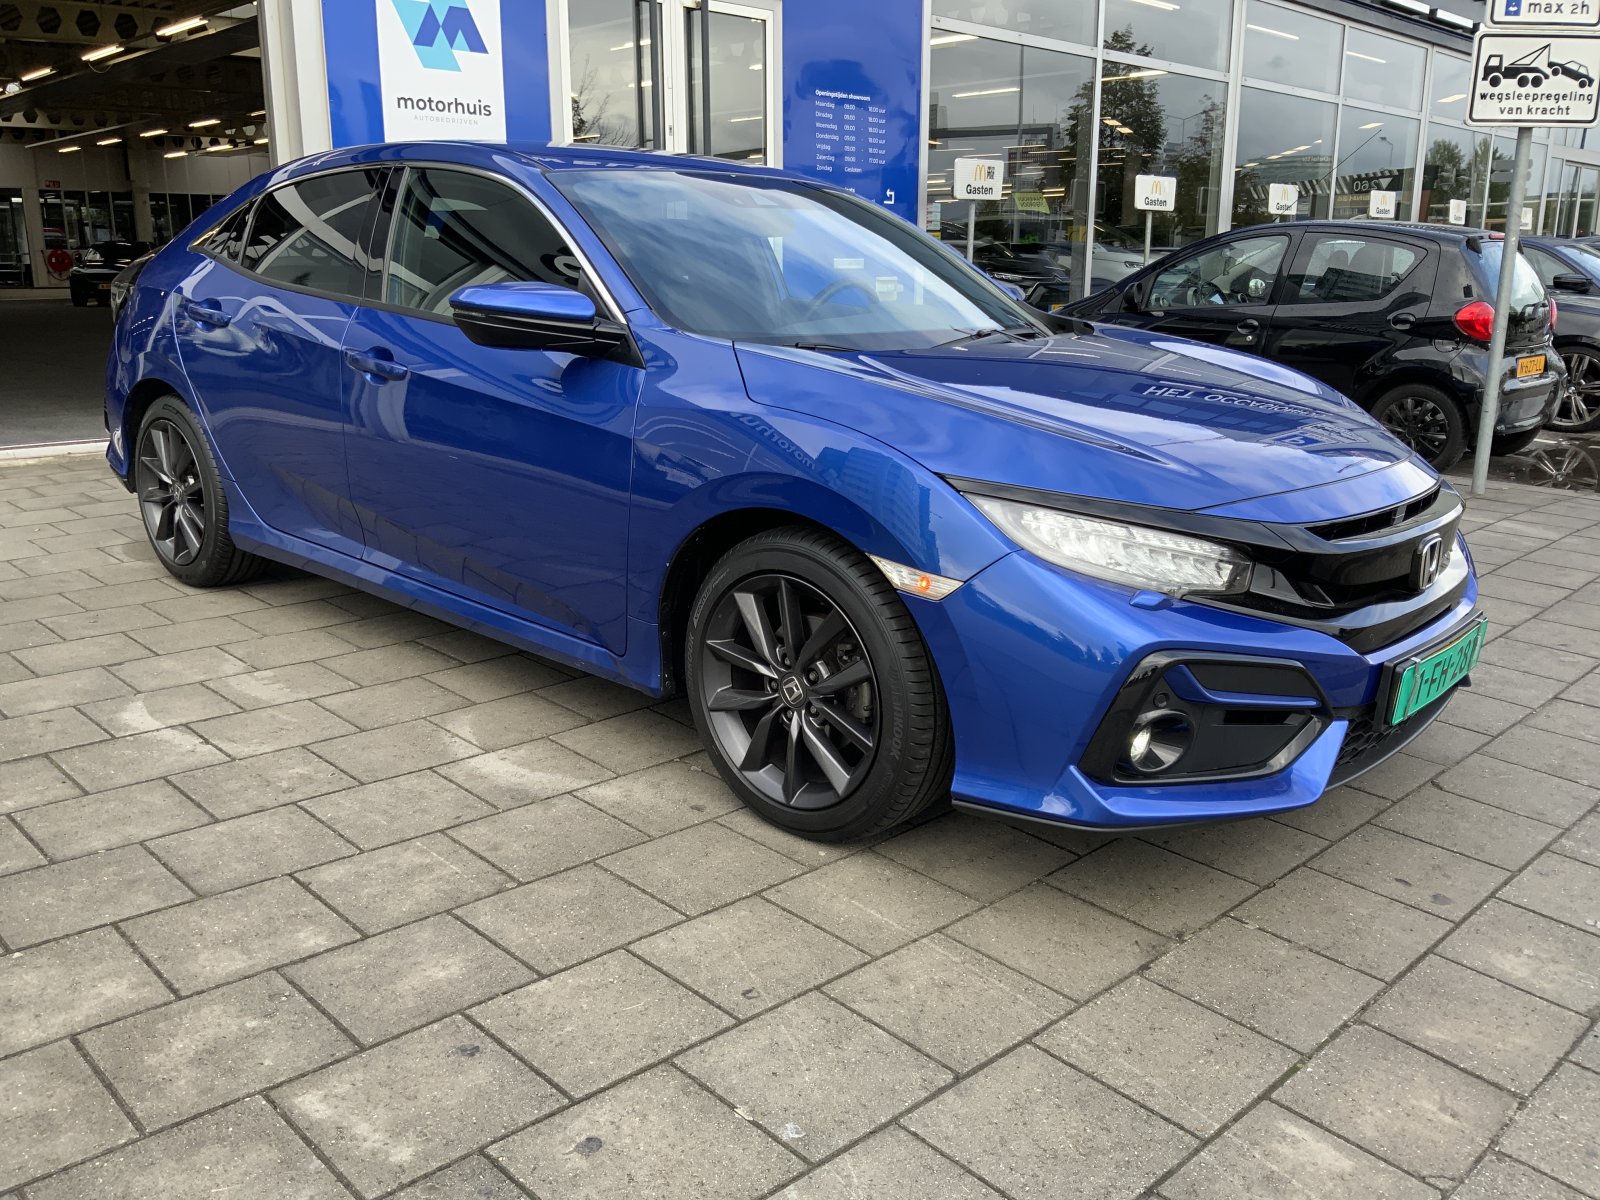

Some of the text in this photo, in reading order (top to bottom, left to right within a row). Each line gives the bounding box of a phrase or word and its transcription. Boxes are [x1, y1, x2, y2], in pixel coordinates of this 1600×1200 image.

[1528, 1, 1590, 14] max 2h
[815, 89, 848, 98] Openingstijden
[1480, 91, 1593, 104] wegsleepregeling
[396, 96, 492, 116] motorhuis
[815, 100, 835, 109] Maandag
[815, 111, 833, 119] Dinsdag
[1500, 105, 1571, 115] van kracht
[413, 115, 479, 125] AUTOBEDRIJVEN
[815, 133, 839, 141] Donderdag
[966, 184, 994, 195] Gasten
[1144, 196, 1167, 206] Gasten
